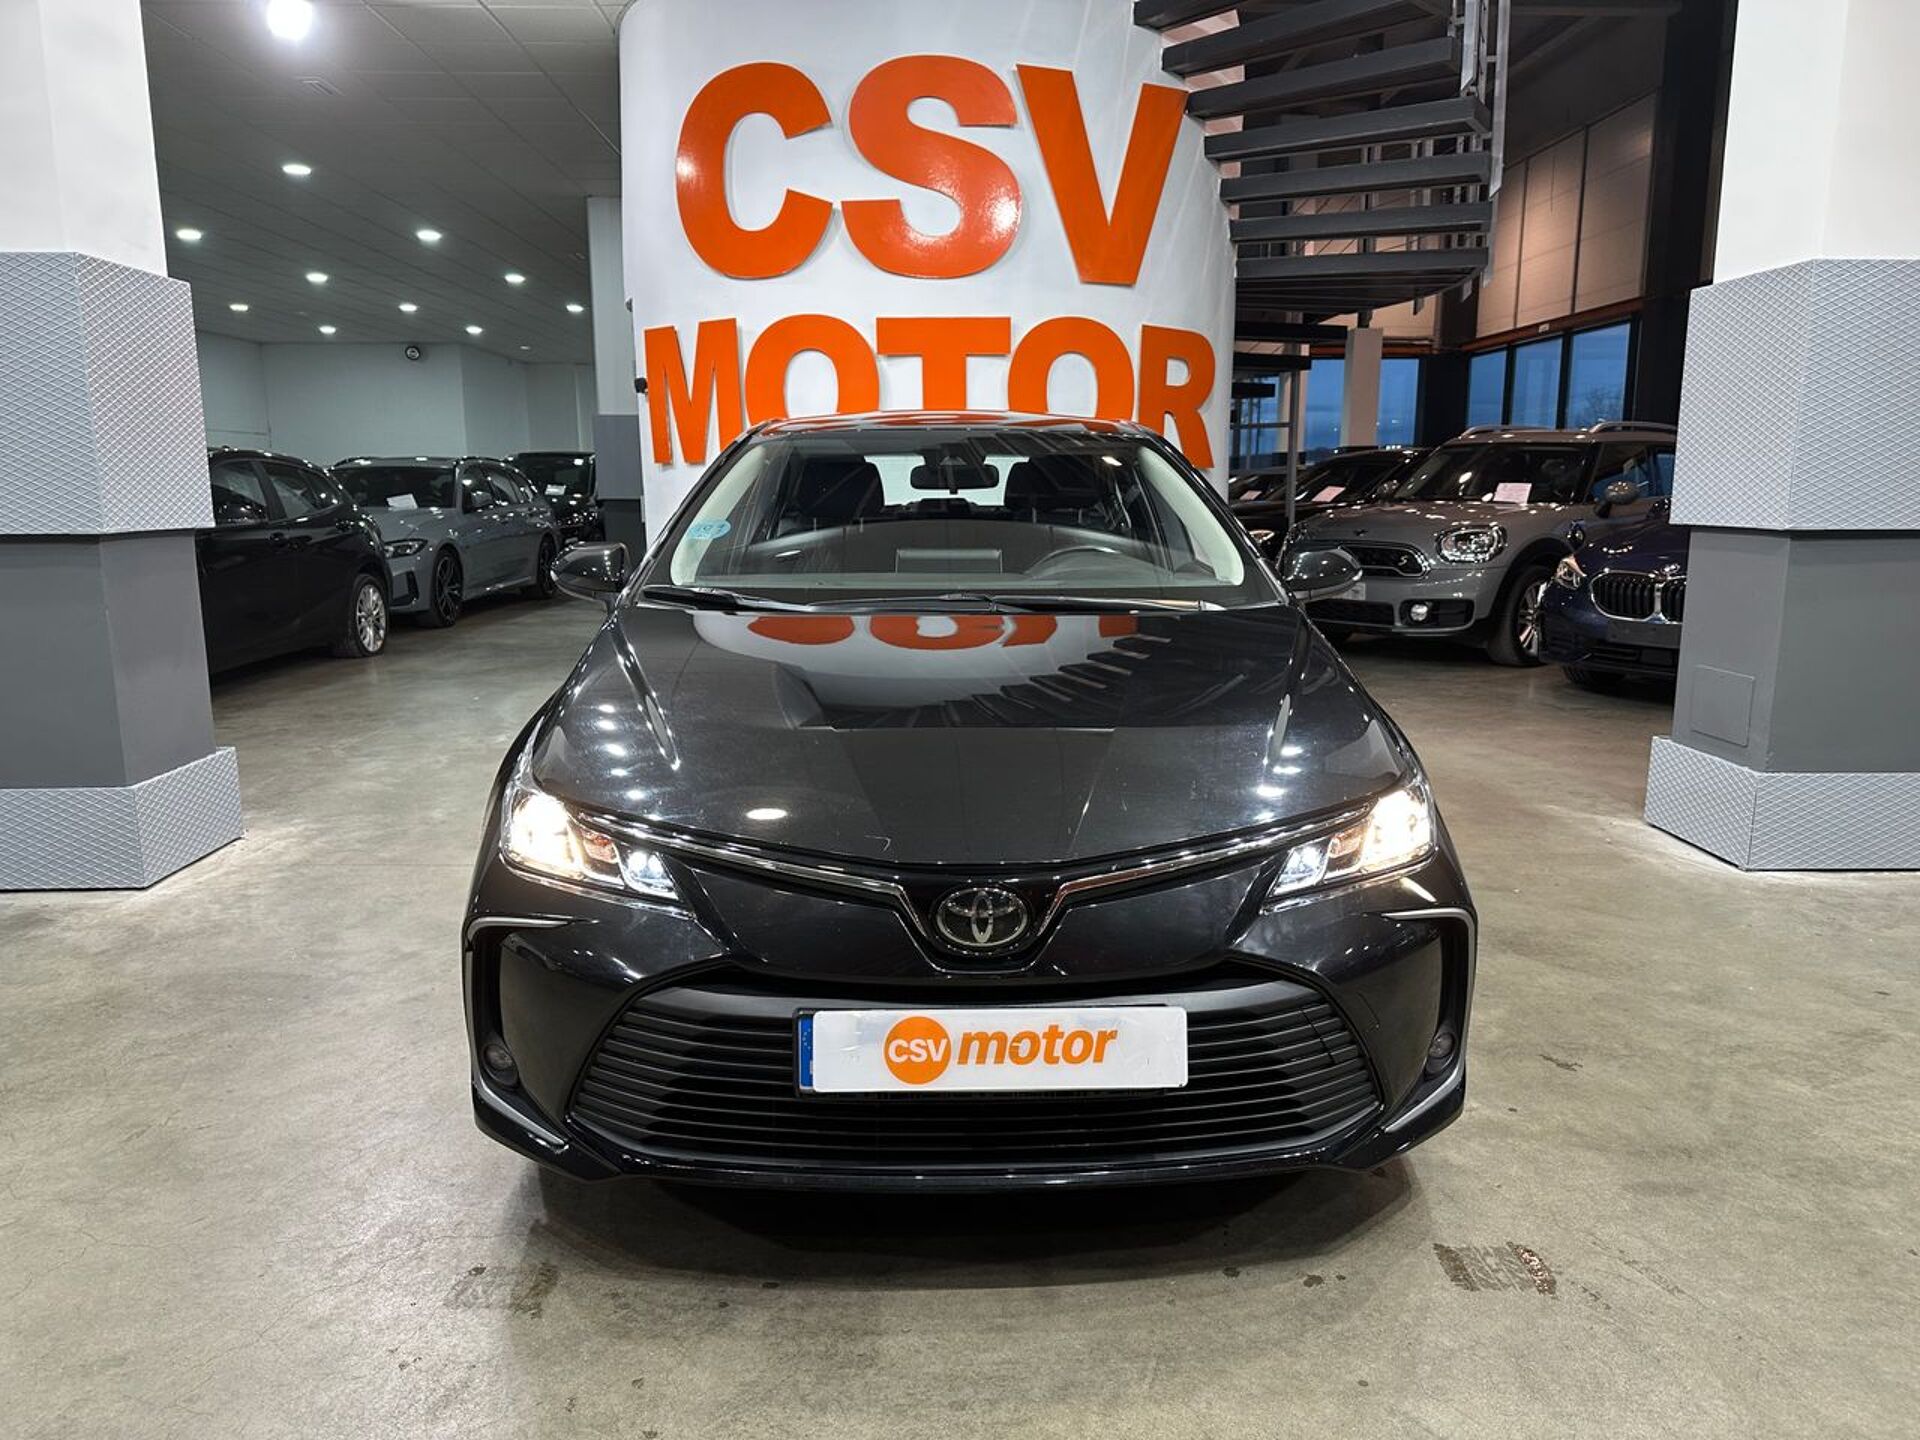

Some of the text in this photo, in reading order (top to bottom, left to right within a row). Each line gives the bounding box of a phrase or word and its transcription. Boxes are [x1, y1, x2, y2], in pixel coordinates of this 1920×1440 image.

[675, 54, 1189, 286] CSV
[644, 313, 1216, 468] MOTOR
[887, 1024, 1118, 1065] CSV motor
